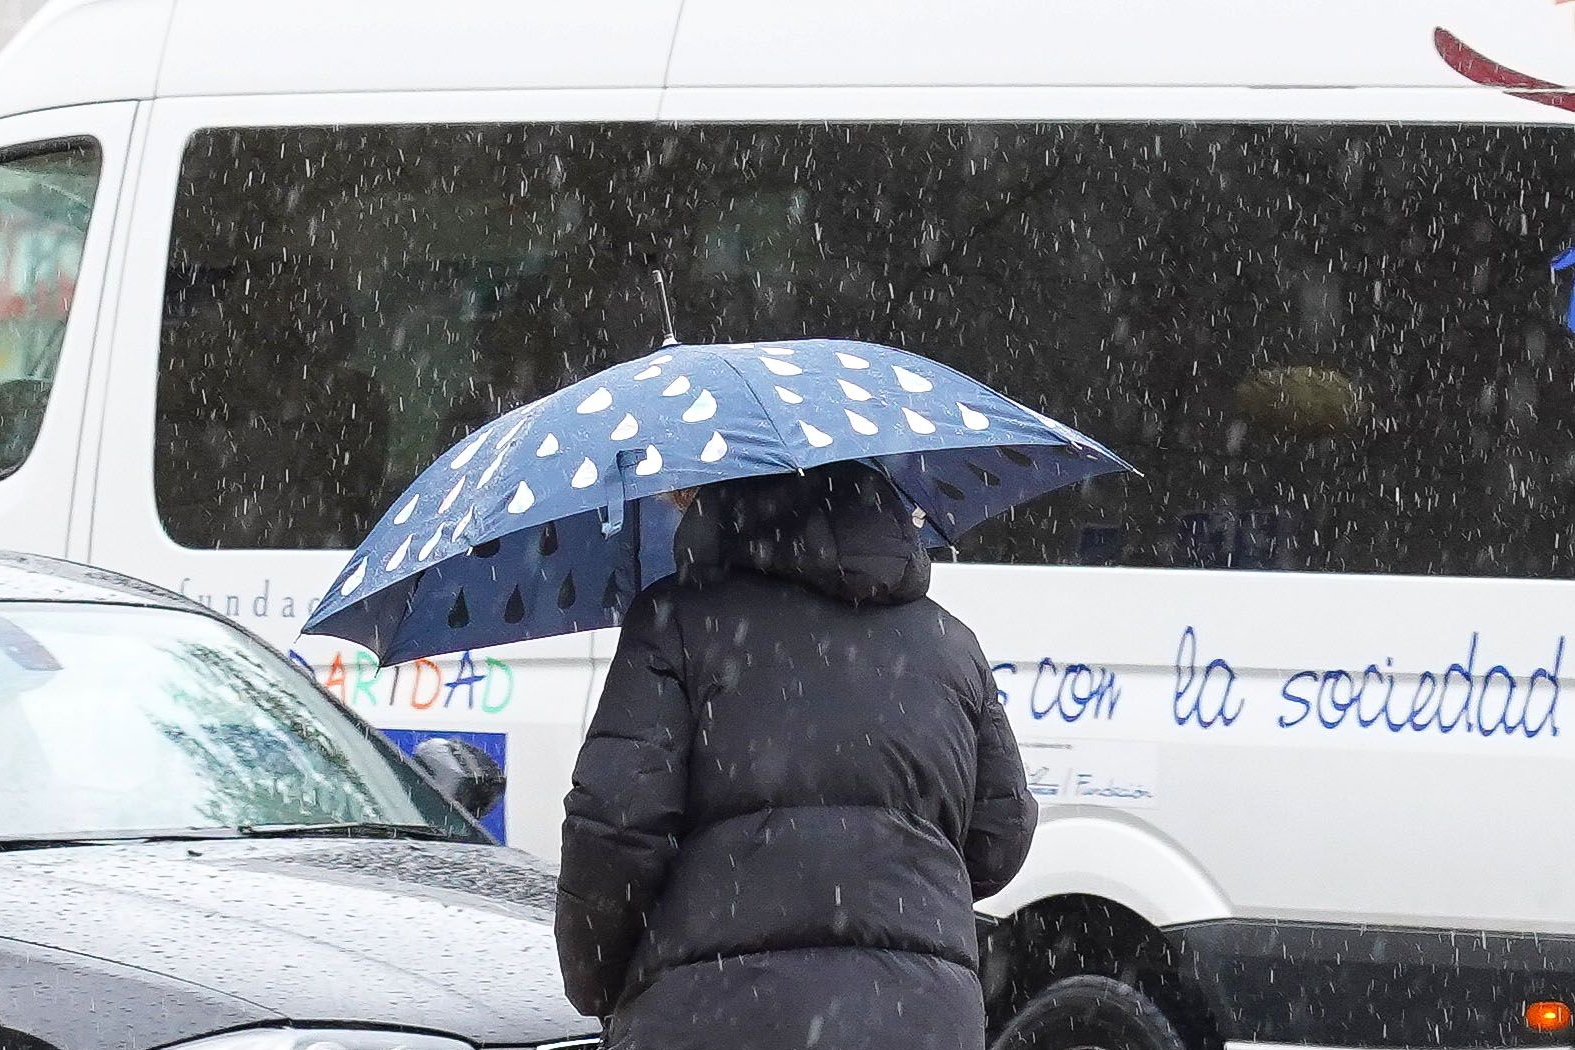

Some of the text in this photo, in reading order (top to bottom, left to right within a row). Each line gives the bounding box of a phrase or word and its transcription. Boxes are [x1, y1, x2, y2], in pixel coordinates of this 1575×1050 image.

[1031, 657, 1121, 722] con
[1174, 626, 1245, 729] la
[1278, 631, 1565, 738] sociedad
